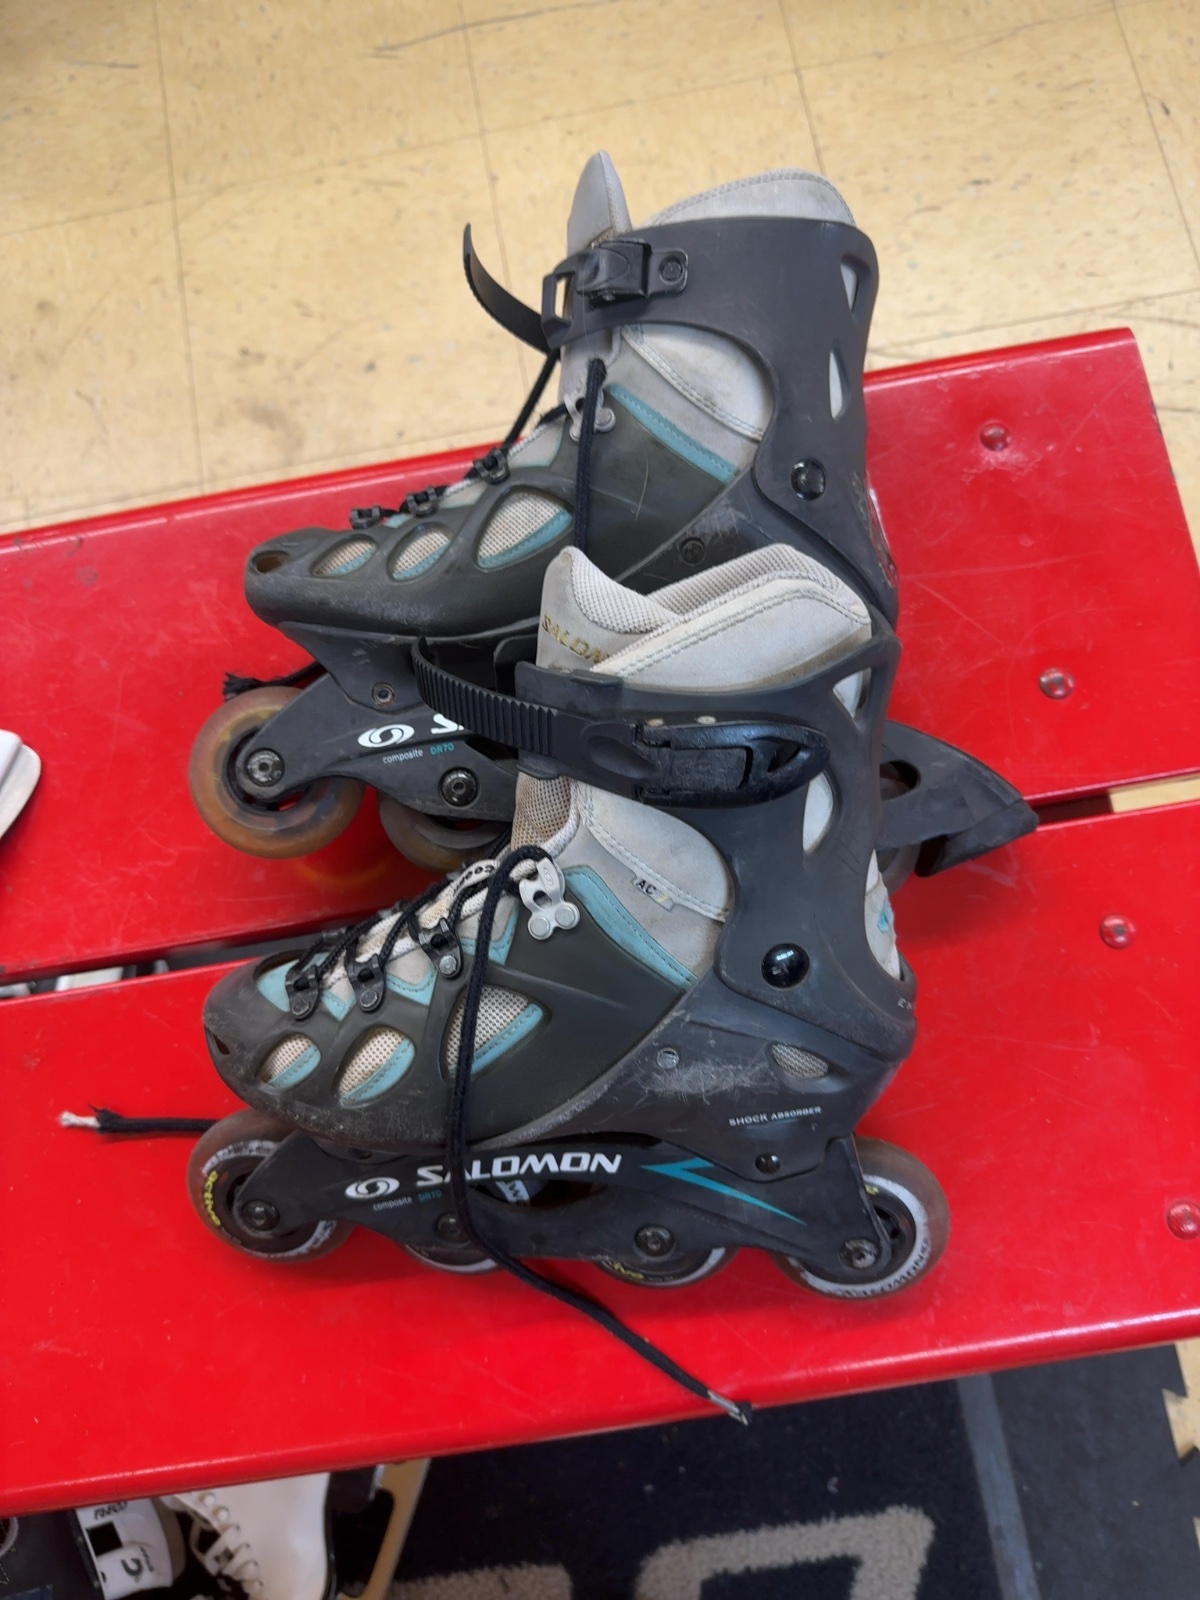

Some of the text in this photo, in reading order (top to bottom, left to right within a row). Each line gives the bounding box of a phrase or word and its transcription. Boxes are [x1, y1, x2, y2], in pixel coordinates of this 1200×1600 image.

[382, 743, 455, 764] composite DR70
[728, 1106, 822, 1126] SHOCK ABSORBER
[415, 1150, 623, 1187] SLOMON
[371, 1195, 414, 1212] composite
